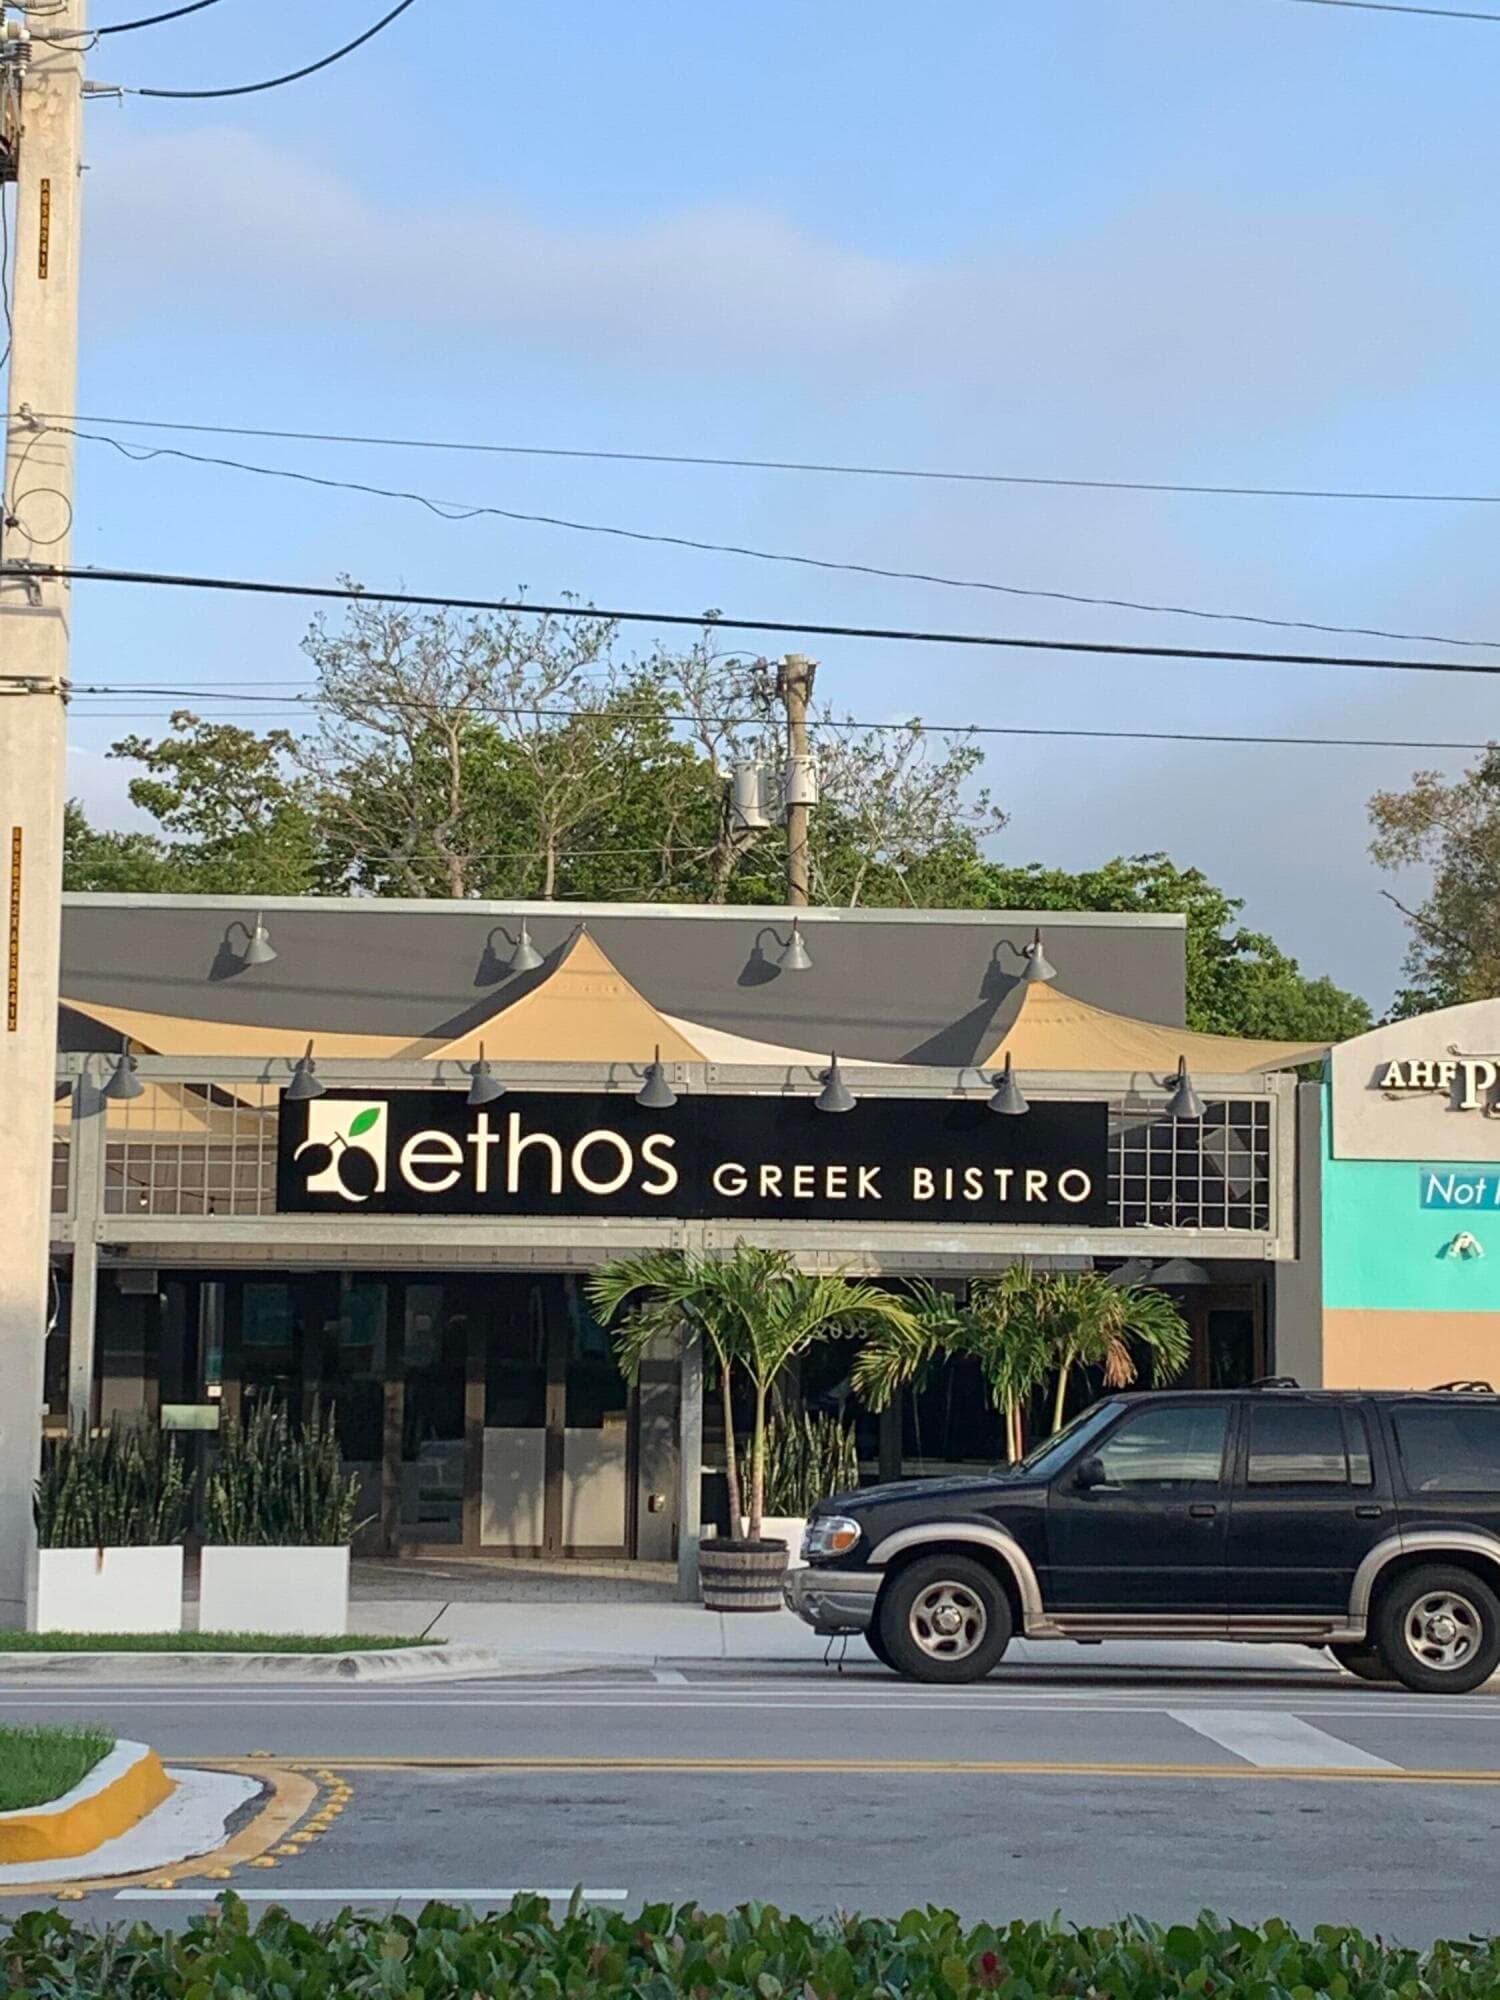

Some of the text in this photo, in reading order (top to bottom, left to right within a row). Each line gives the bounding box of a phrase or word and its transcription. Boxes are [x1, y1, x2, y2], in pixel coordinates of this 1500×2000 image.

[1380, 1060, 1500, 1109] AHF P
[399, 1112, 678, 1195] ethos
[713, 1162, 1091, 1203] GREEK BISTRO
[1425, 1173, 1488, 1205] Not
